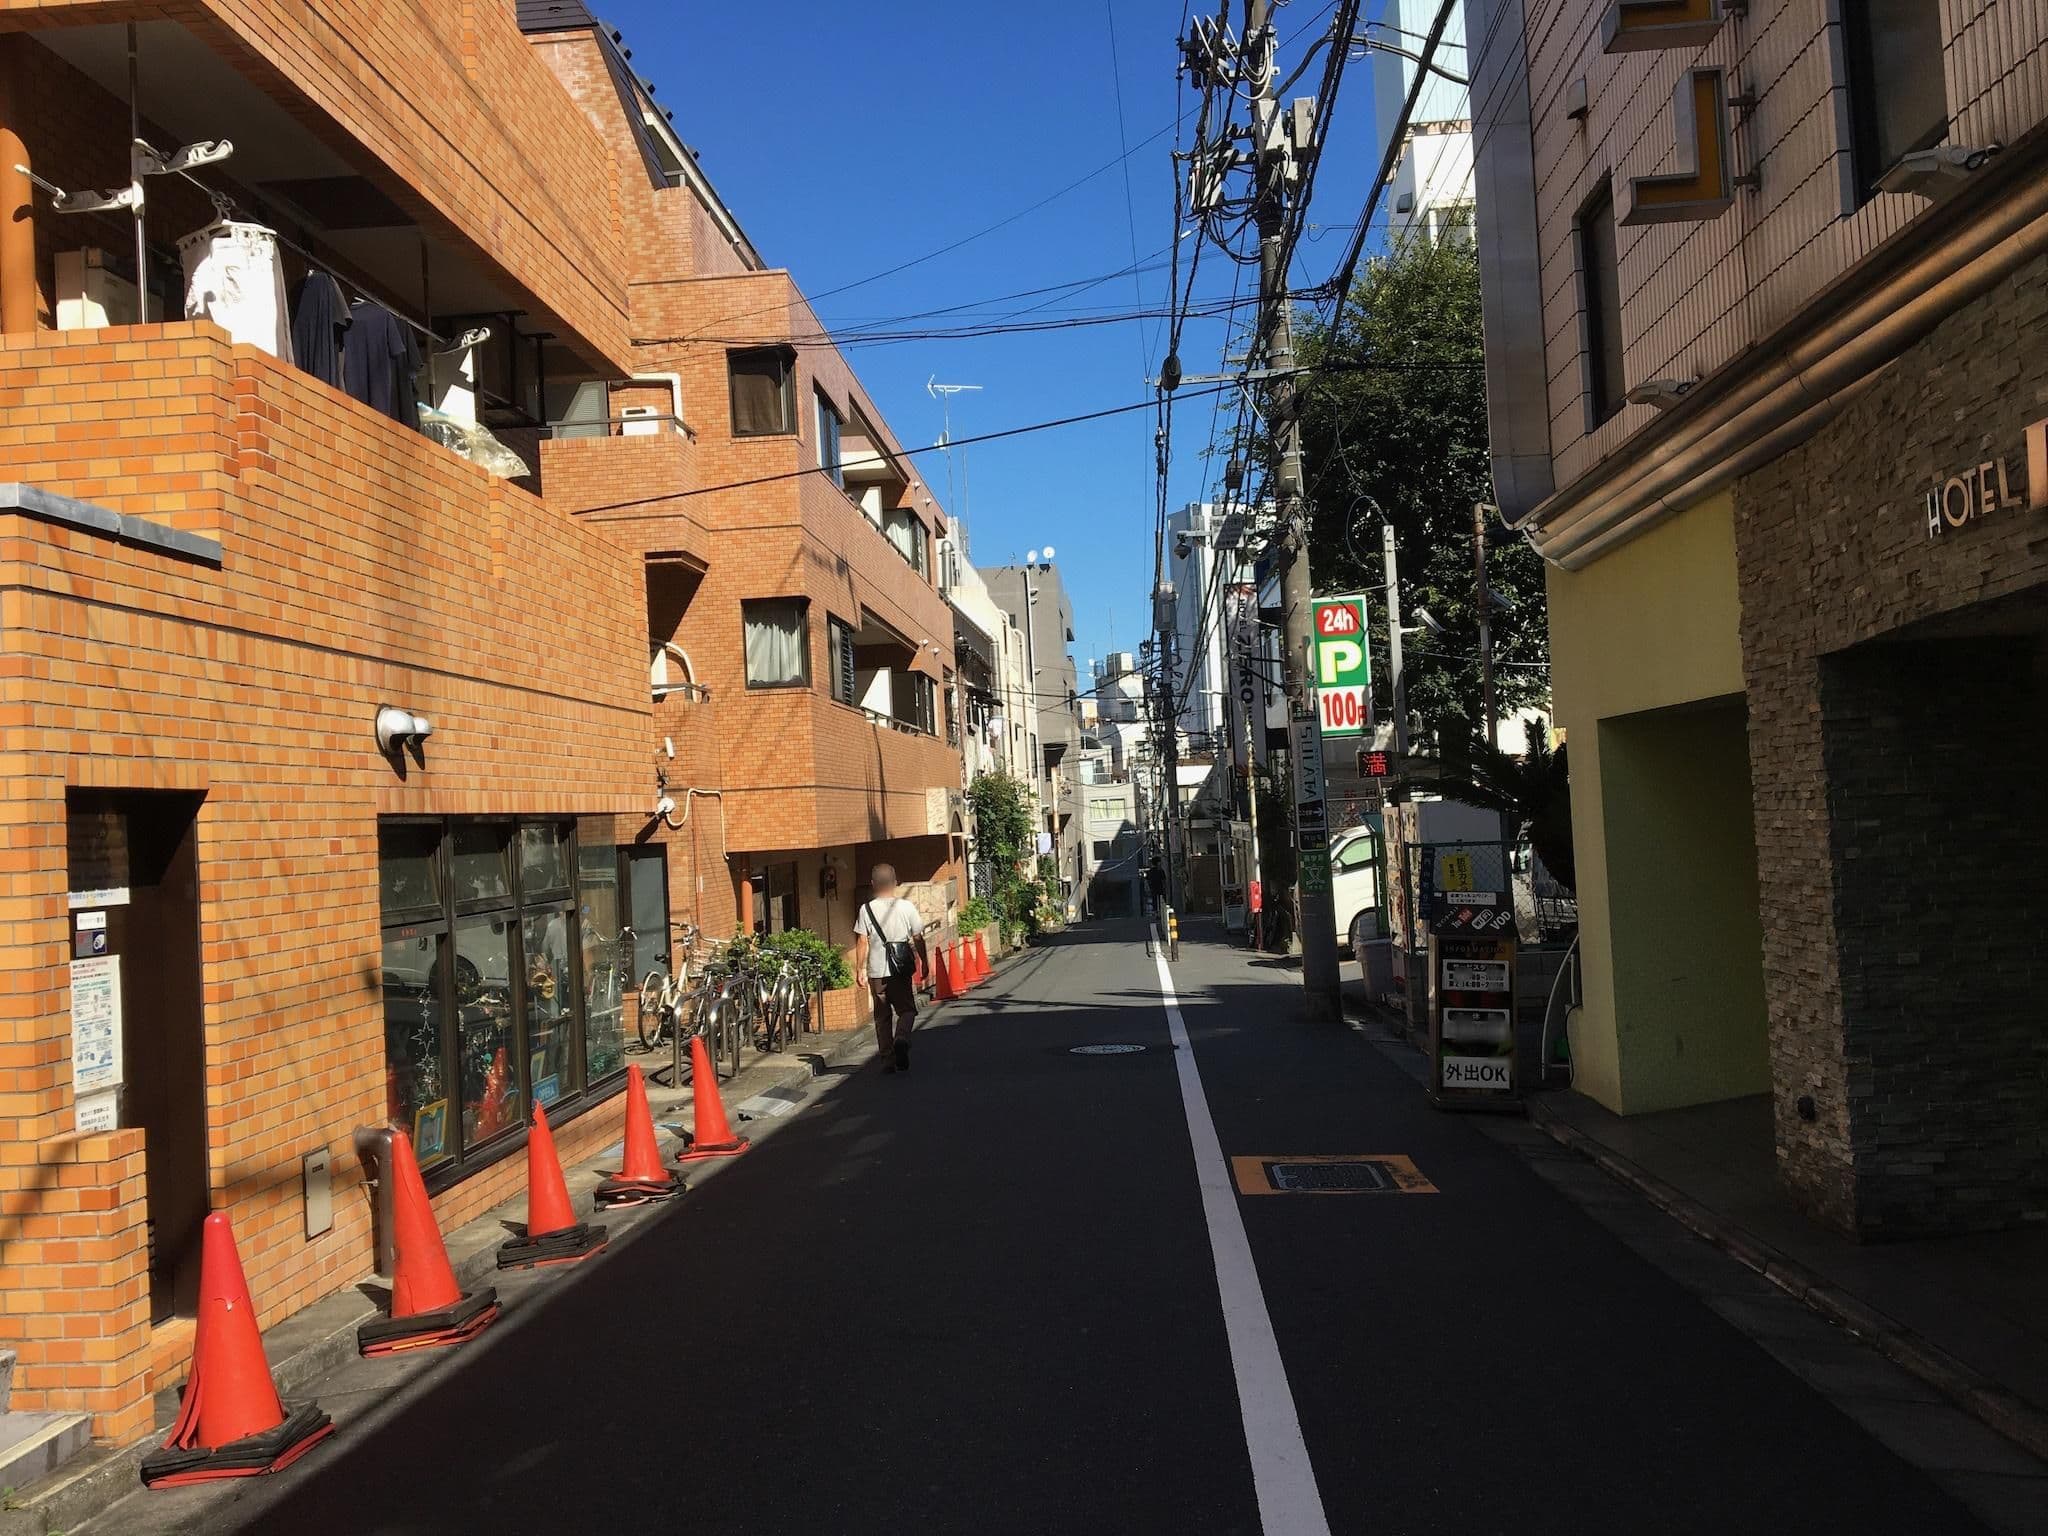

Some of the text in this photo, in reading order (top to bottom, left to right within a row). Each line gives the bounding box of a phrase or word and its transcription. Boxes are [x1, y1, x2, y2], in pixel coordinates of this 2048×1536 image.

[1926, 456, 2022, 540] HOTEL
[1323, 608, 1354, 632] 24h
[1319, 640, 1363, 684] P
[1323, 692, 1368, 728] 100円
[1300, 726, 1318, 800] SULATA
[1362, 752, 1388, 777] 満
[1489, 911, 1511, 930] VOD
[1446, 1063, 1506, 1082] 外出OK
